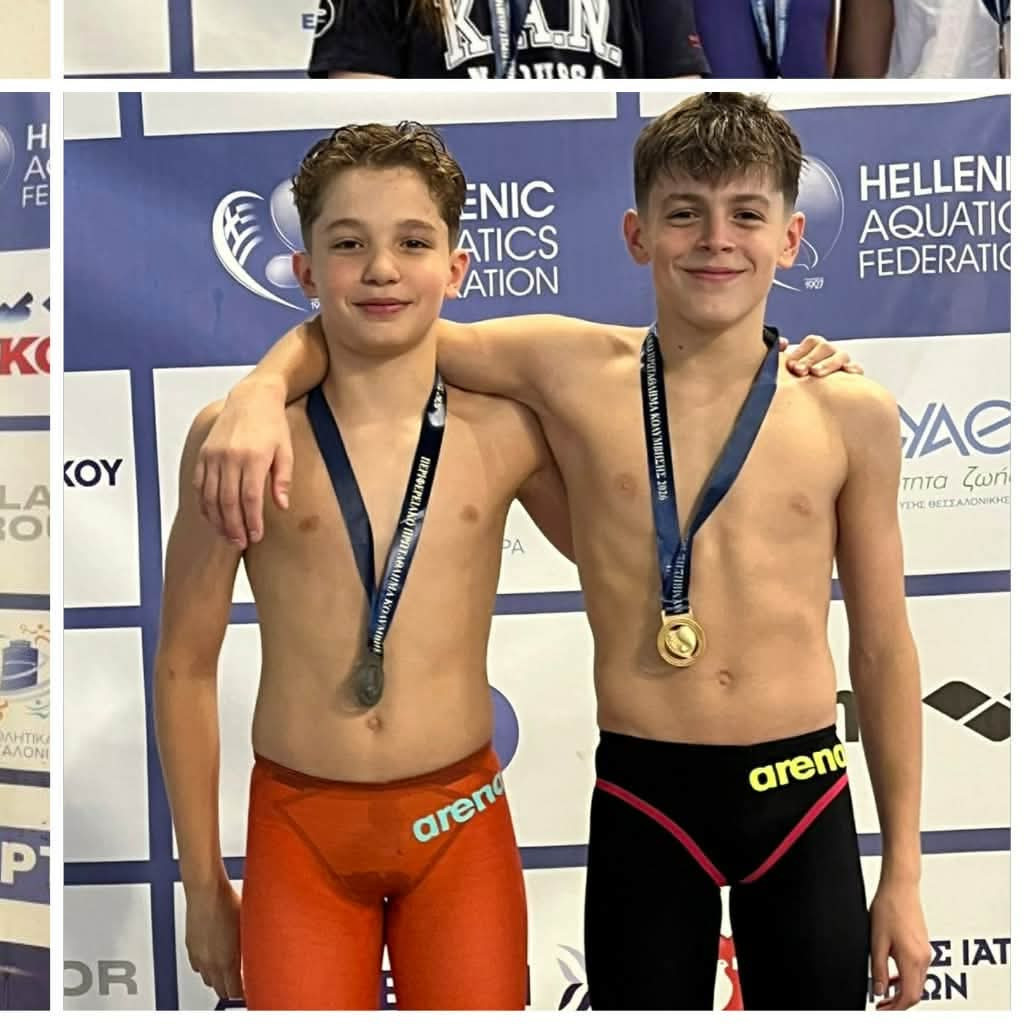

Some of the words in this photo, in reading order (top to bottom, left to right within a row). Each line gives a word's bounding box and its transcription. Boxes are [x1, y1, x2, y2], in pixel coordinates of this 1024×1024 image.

[457, 265, 559, 297] ATION
[650, 412, 666, 478] ΚΟΛΥΜΒΗΣΗΣ
[402, 455, 432, 528] ΠΕΡΙΦΕΡΕΙΑΚΟ
[657, 480, 668, 501] 2026
[963, 465, 1010, 492] ζωή
